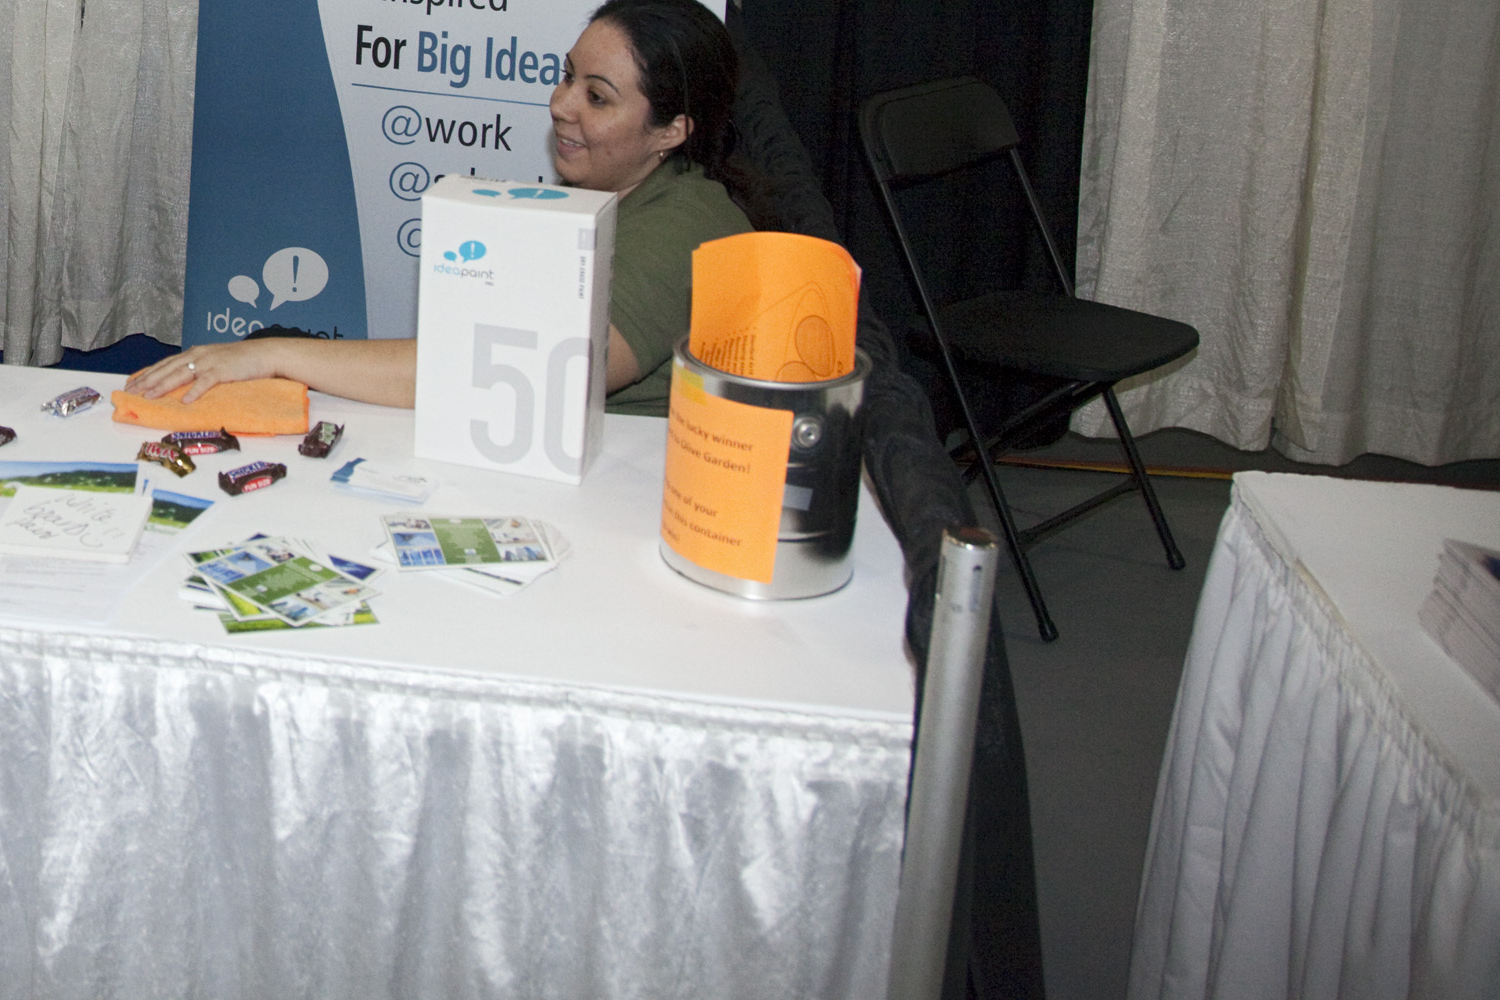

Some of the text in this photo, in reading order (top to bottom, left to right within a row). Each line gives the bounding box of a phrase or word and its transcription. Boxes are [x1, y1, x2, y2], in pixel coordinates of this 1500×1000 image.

[355, 24, 566, 88] For Big Idea
[381, 105, 512, 153] @work
[434, 263, 494, 280] ideapaint
[470, 323, 593, 476] 50
[711, 434, 754, 452] winner
[703, 452, 751, 474] Garden!
[693, 502, 718, 518] your
[689, 522, 742, 547] container
